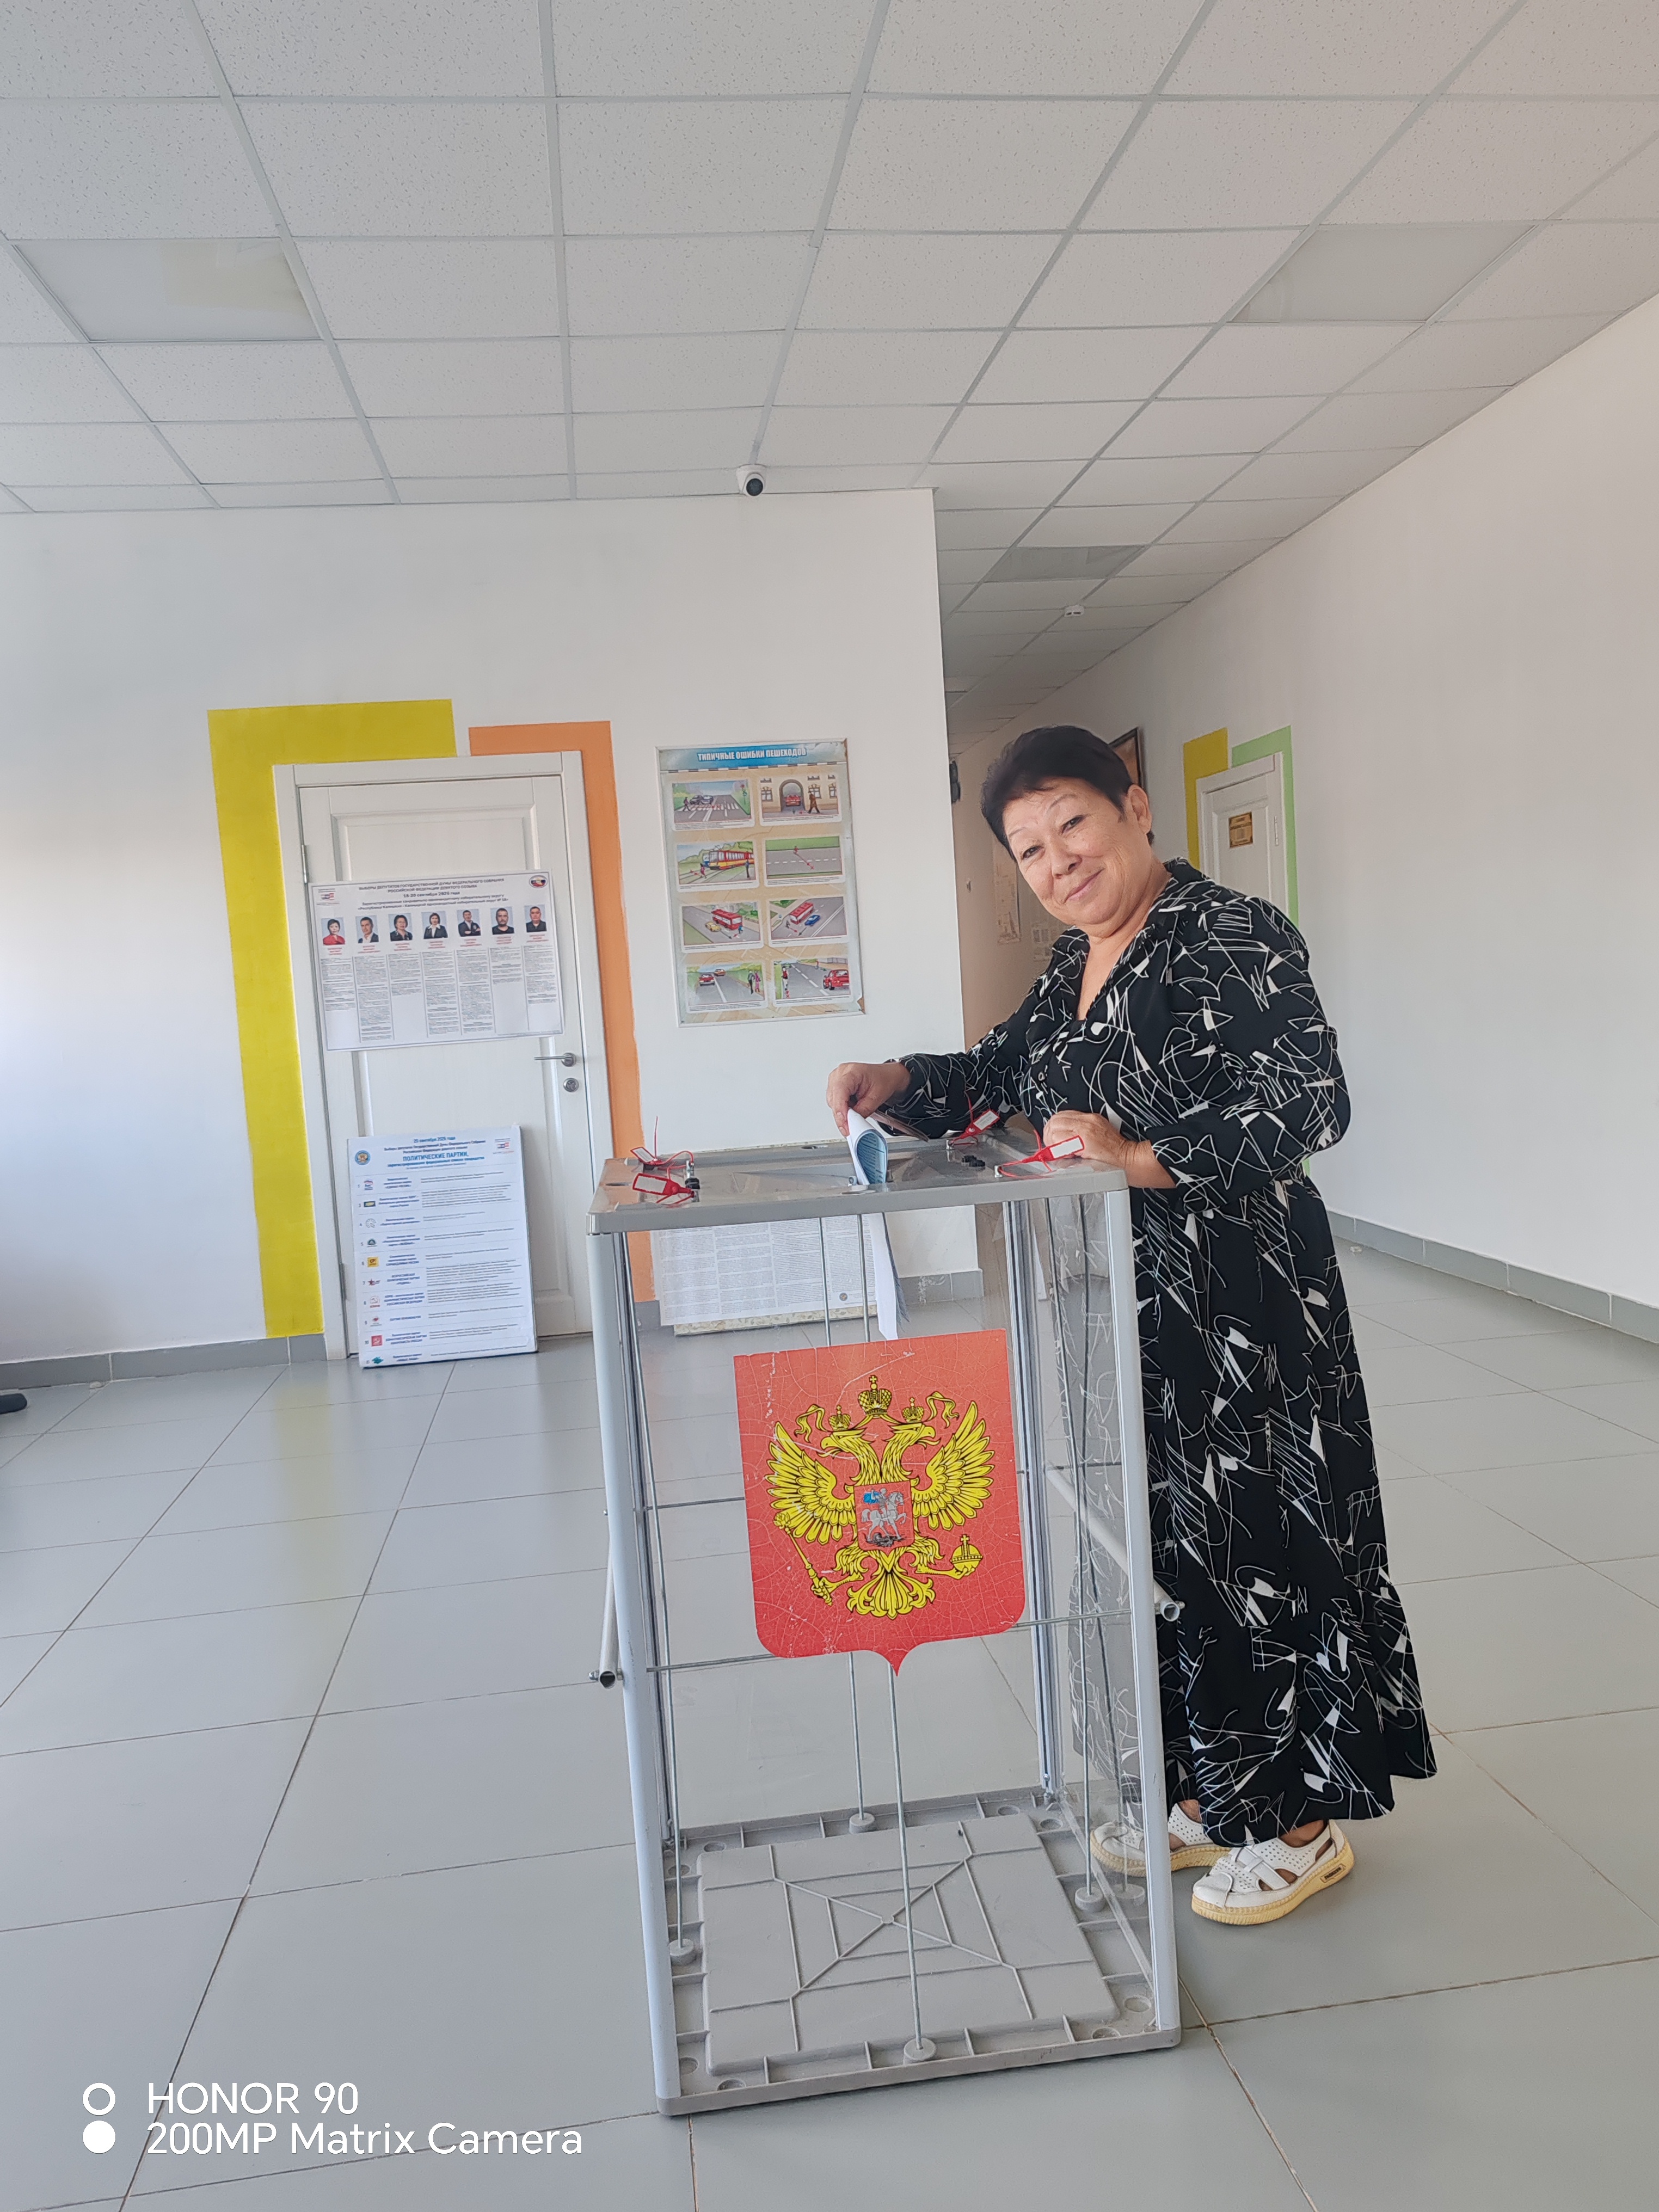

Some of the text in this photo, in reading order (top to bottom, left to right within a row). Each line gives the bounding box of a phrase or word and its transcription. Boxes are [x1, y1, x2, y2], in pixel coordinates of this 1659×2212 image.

[697, 748, 807, 761] ТИПИЧНЫЕ ОШИБКИ ПЕШЕХОДОВ
[403, 1153, 445, 1162] ПОЛИТИЧЕСКИЕ
